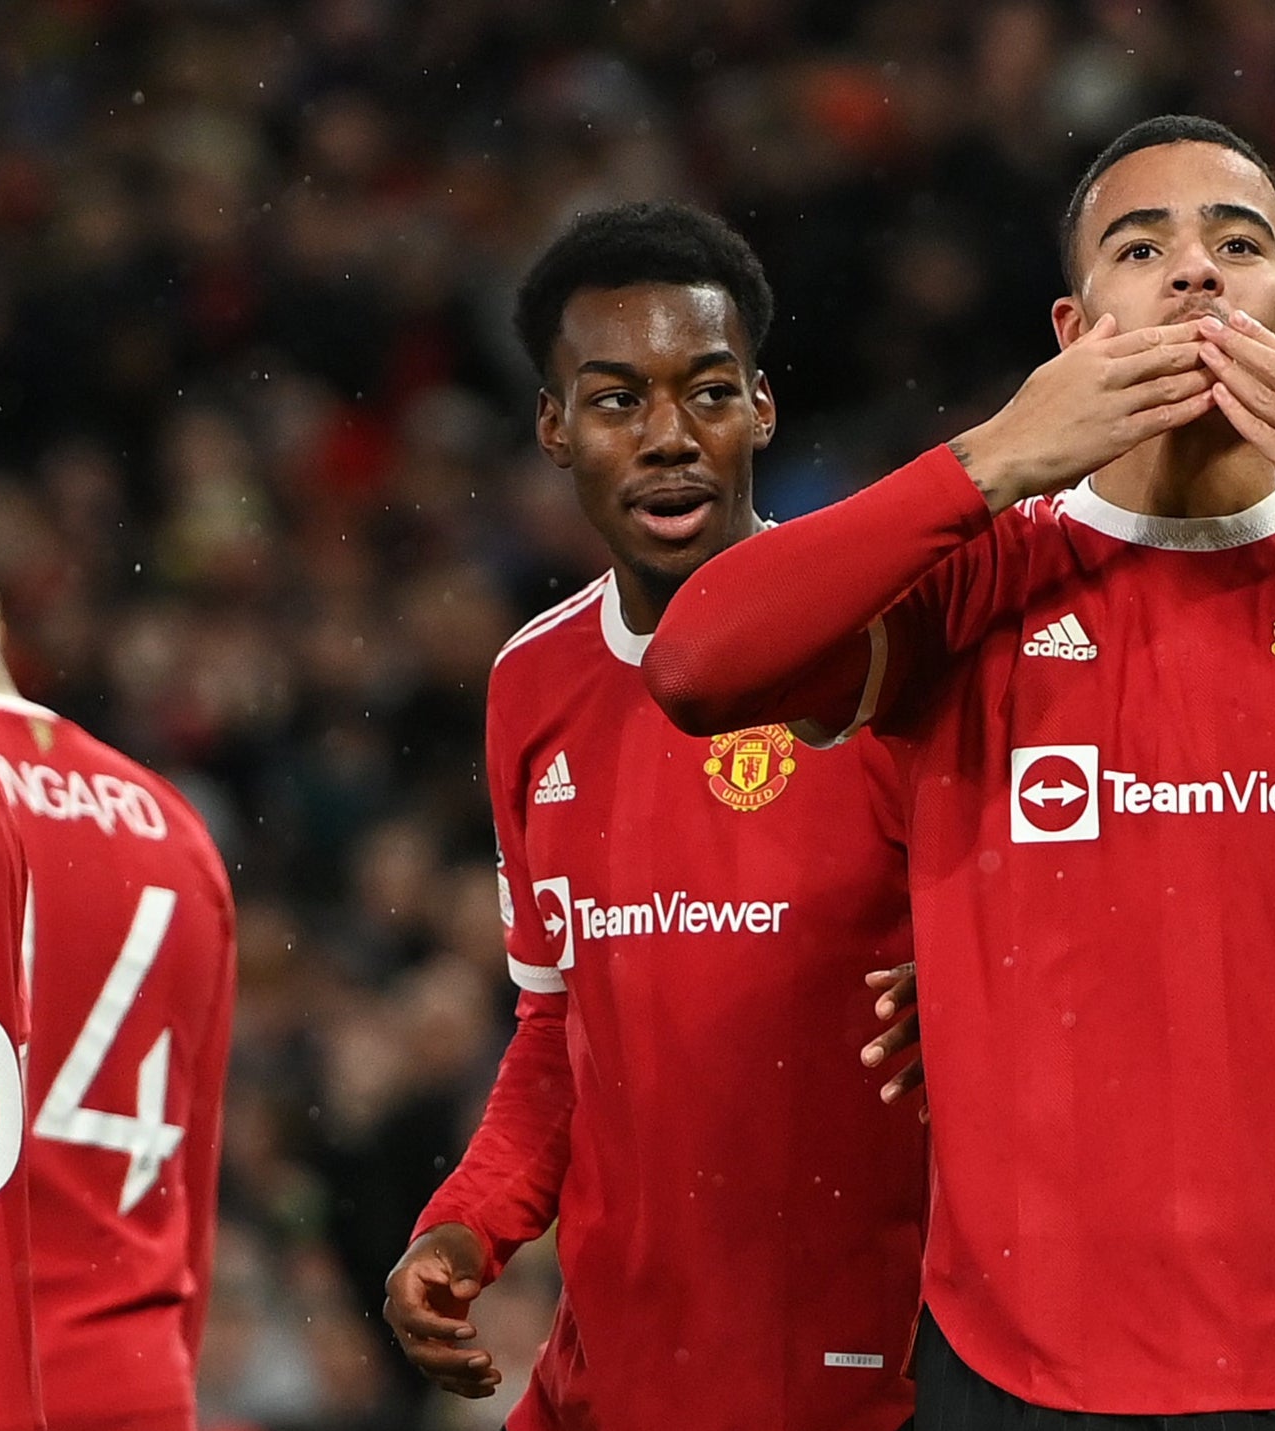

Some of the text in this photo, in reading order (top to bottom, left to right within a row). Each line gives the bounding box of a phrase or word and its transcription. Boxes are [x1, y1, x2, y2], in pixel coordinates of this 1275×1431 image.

[1024, 640, 1098, 662] adidas
[534, 782, 576, 805] adidas
[722, 788, 774, 805] UNITED
[574, 891, 790, 940] TeamViewer
[21, 868, 186, 1218] 4
